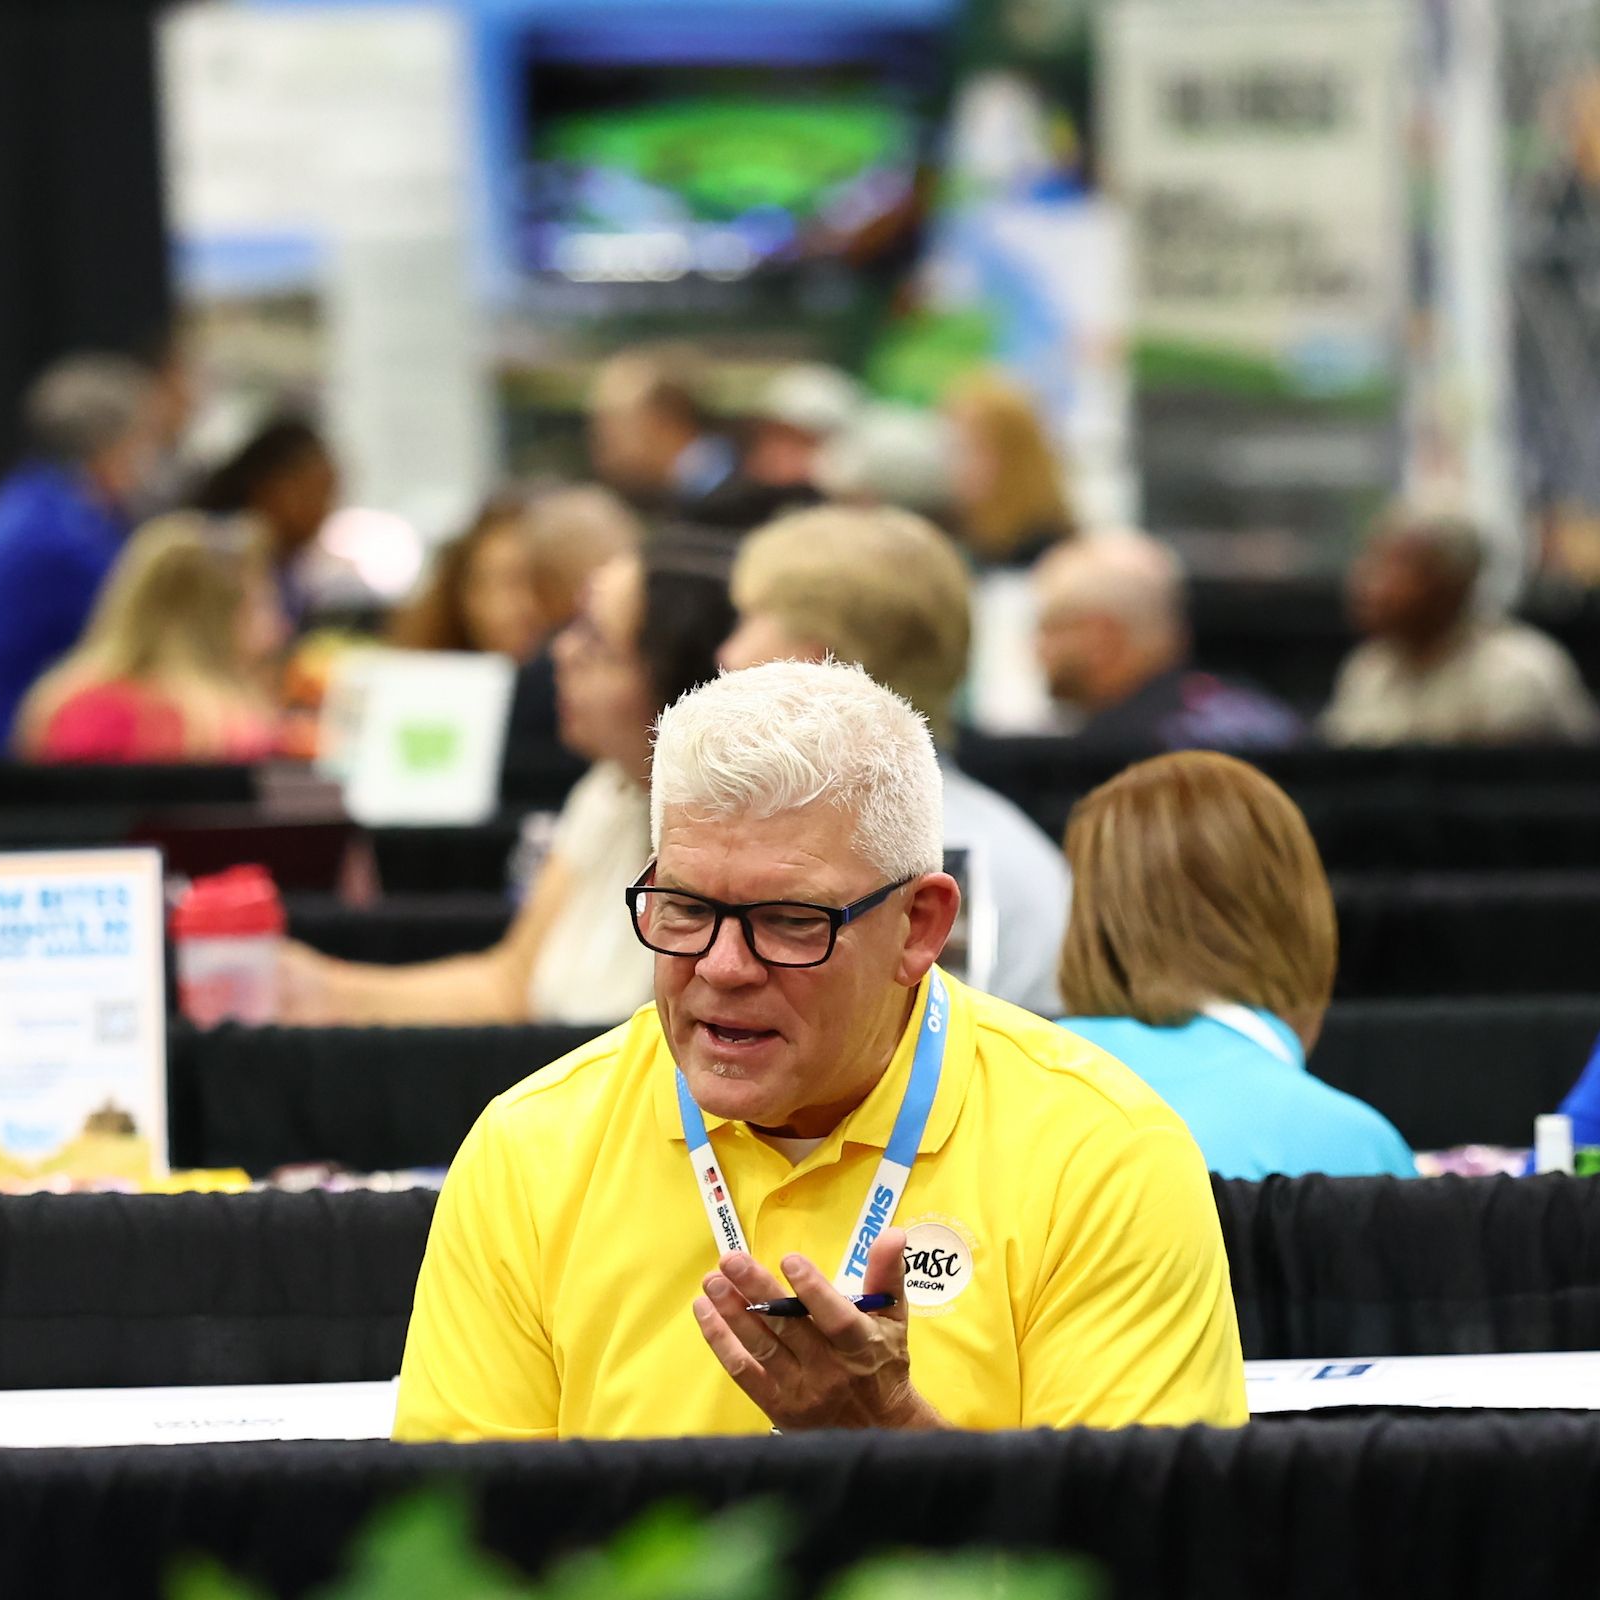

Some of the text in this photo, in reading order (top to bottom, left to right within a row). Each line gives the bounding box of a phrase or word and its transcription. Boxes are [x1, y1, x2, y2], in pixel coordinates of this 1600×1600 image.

[928, 1002, 942, 1033] OF
[717, 1206, 736, 1251] SPORTS
[907, 1280, 945, 1291] OREGON
